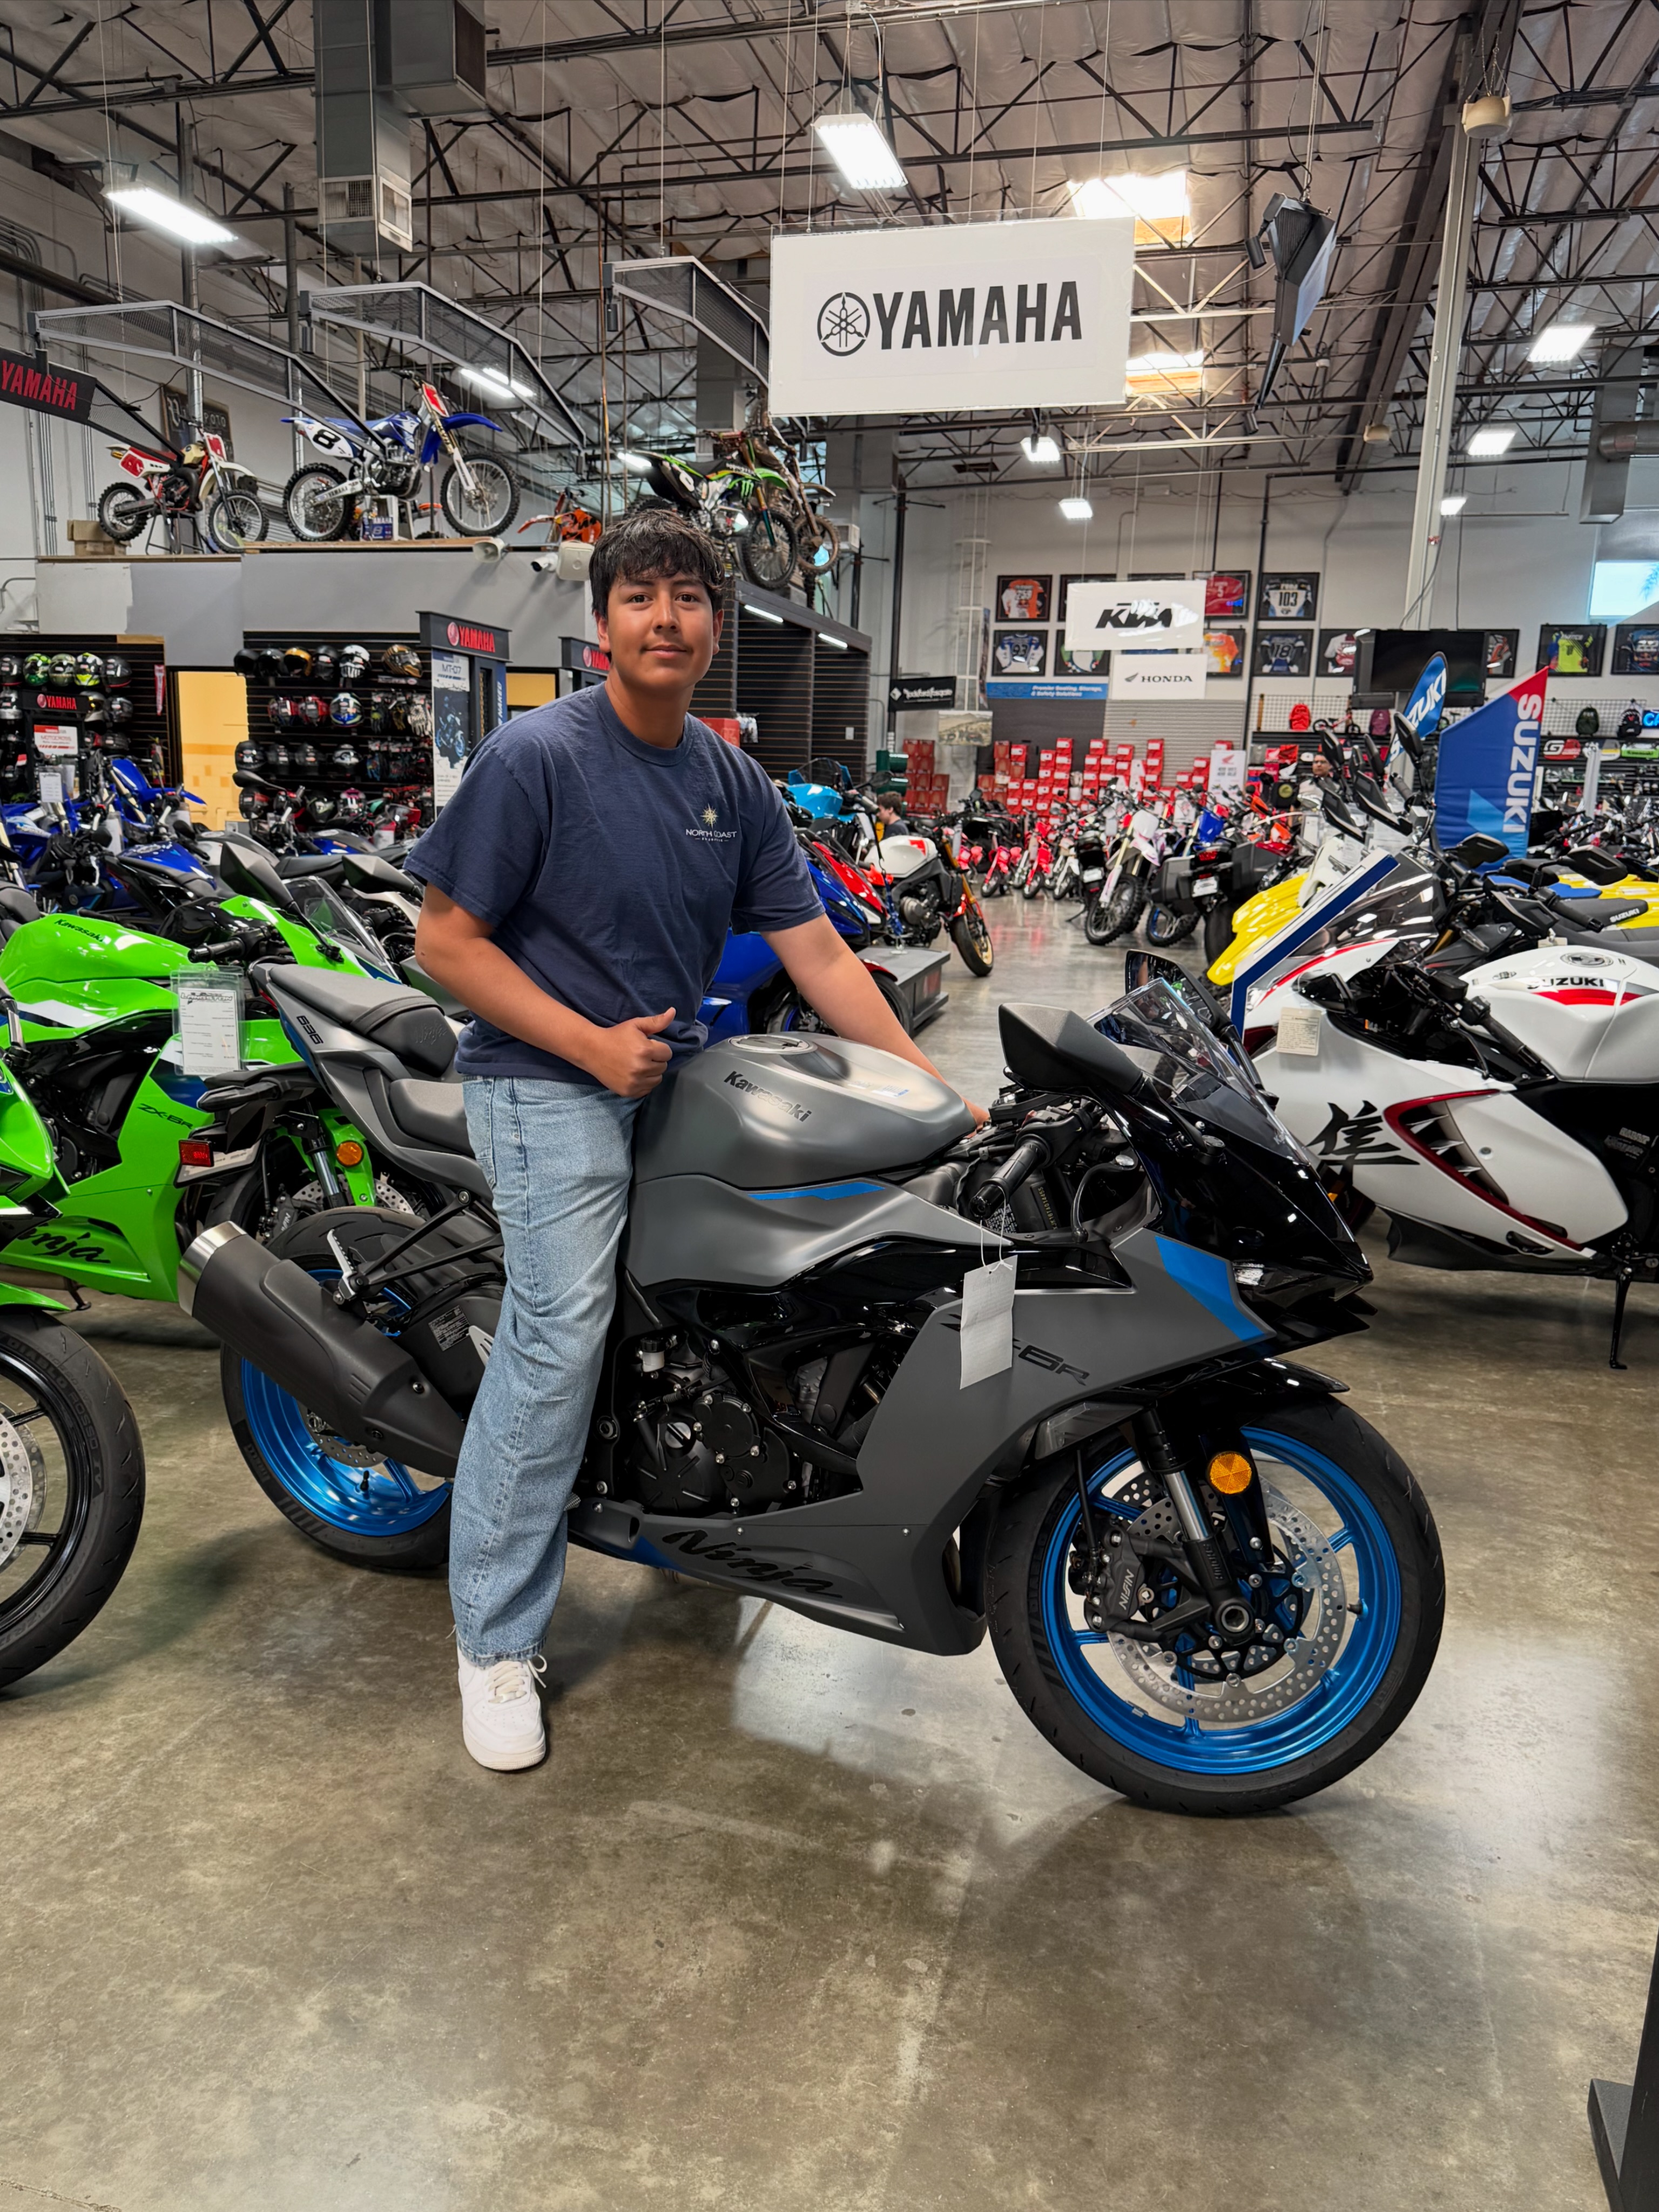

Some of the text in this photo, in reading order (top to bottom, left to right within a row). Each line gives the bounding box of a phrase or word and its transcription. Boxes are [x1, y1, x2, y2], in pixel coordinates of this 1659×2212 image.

[873, 281, 1082, 350] YAMAHA
[2, 360, 77, 410] YAMAHA
[313, 429, 341, 450] 8
[1278, 591, 1298, 607] 103
[459, 625, 496, 653] YAMAHA
[46, 695, 77, 710] YAMAHA
[1390, 668, 1447, 762] SZUKI
[1502, 693, 1542, 833] SUZUKI
[686, 828, 712, 837] NORTH
[1609, 908, 1640, 922] SUZUKI
[296, 1015, 324, 1045] 636
[723, 1070, 812, 1122] Kawasaki
[137, 1103, 194, 1130] ZX-6R
[1305, 1100, 1421, 1188] 隼
[68, 1391, 99, 1451] ROSSO
[662, 1529, 843, 1599] Ninja
